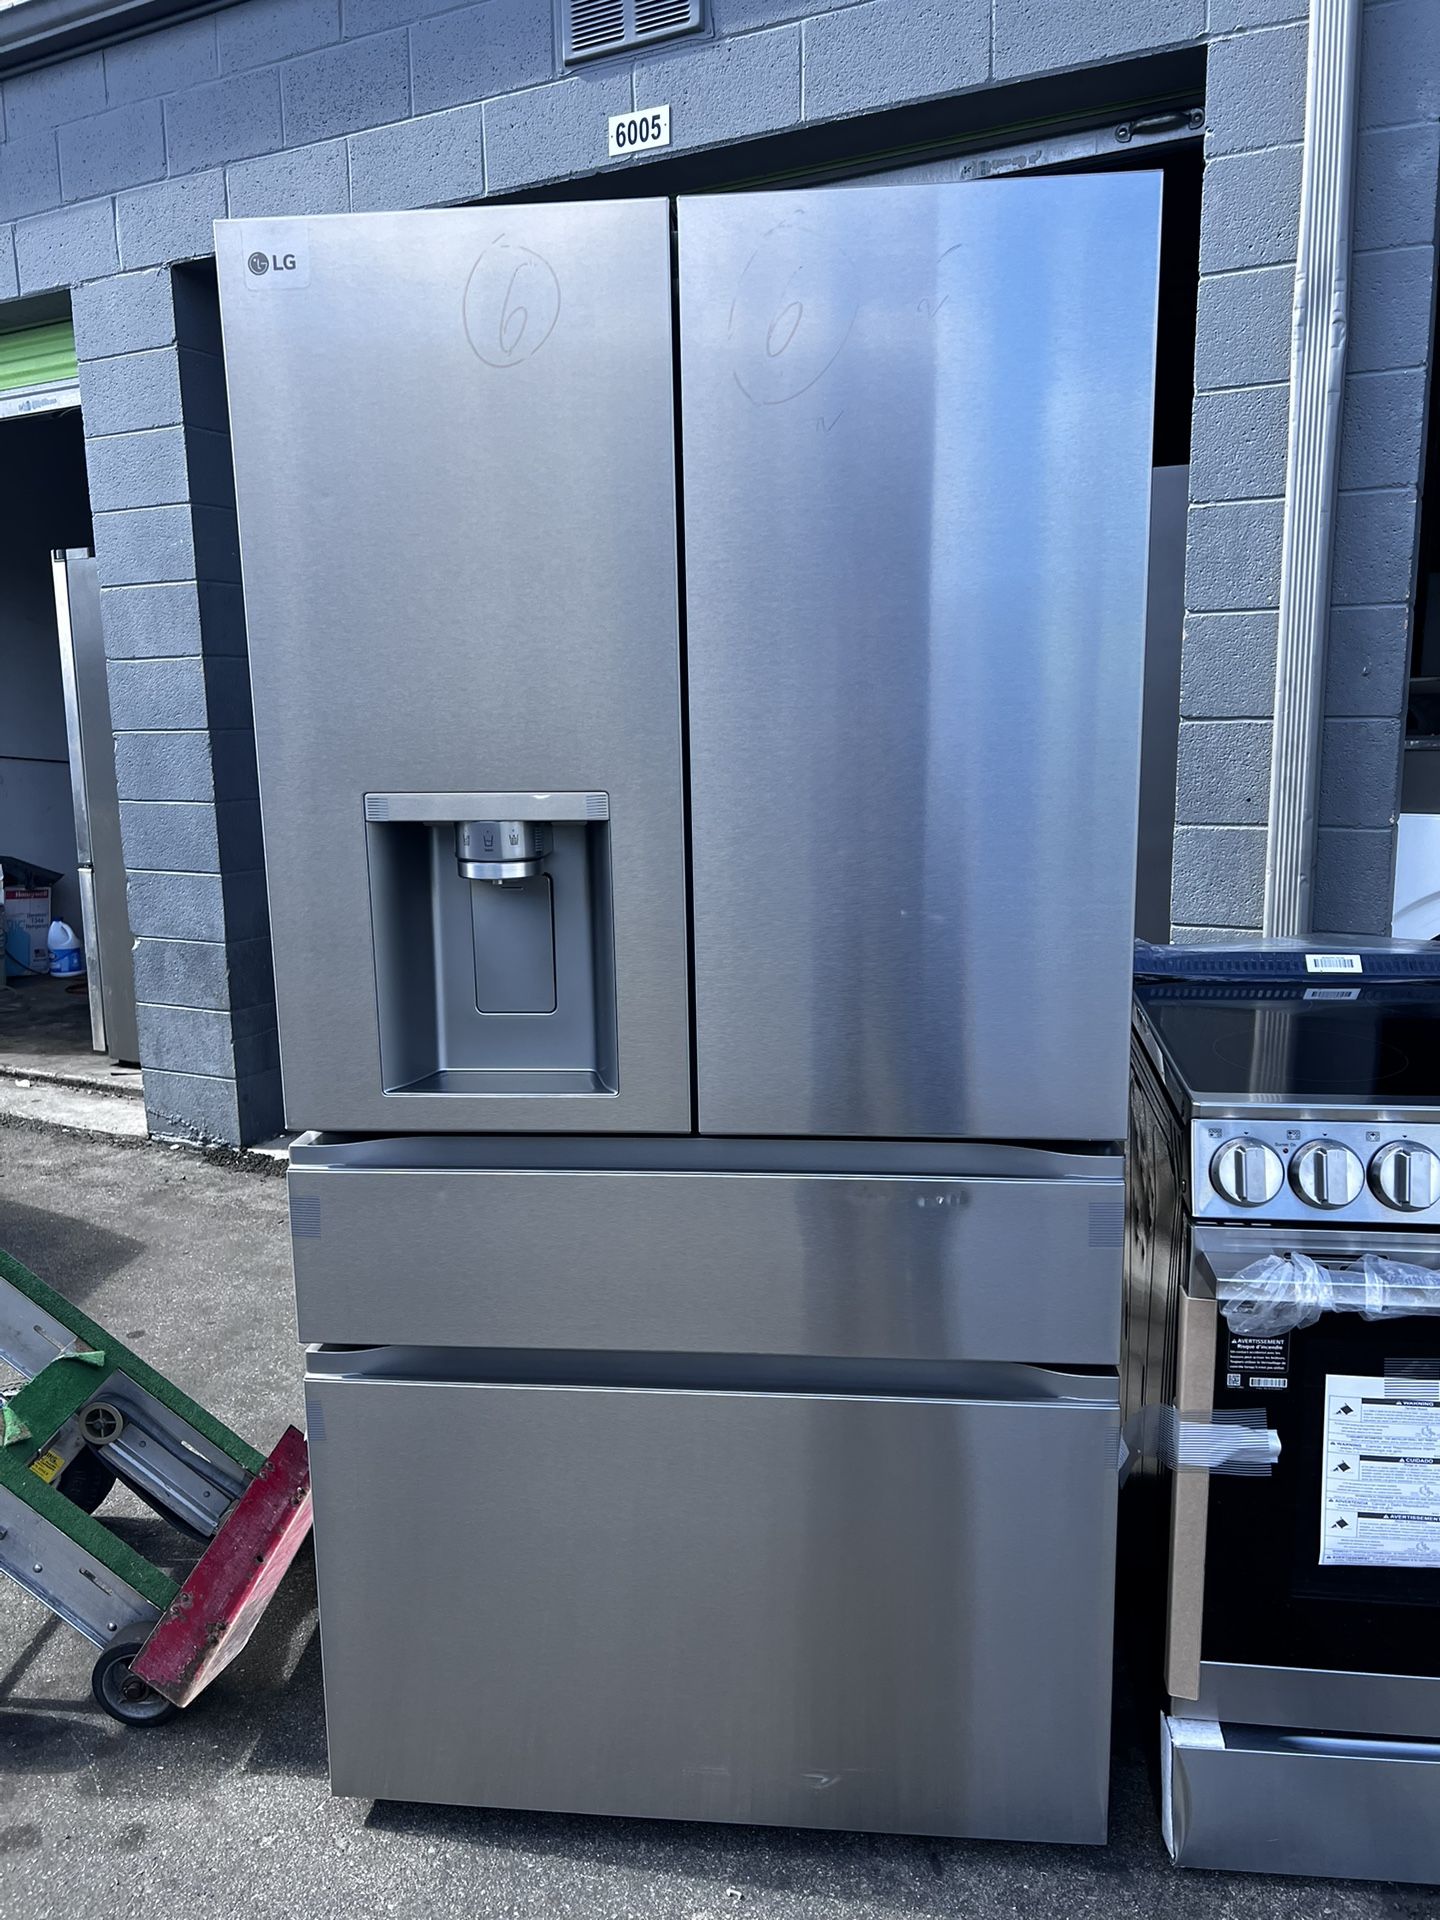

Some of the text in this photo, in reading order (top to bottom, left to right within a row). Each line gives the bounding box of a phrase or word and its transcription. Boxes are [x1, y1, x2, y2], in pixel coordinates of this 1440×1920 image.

[616, 114, 662, 148] 6005
[272, 253, 297, 272] LG
[500, 261, 537, 357] 6
